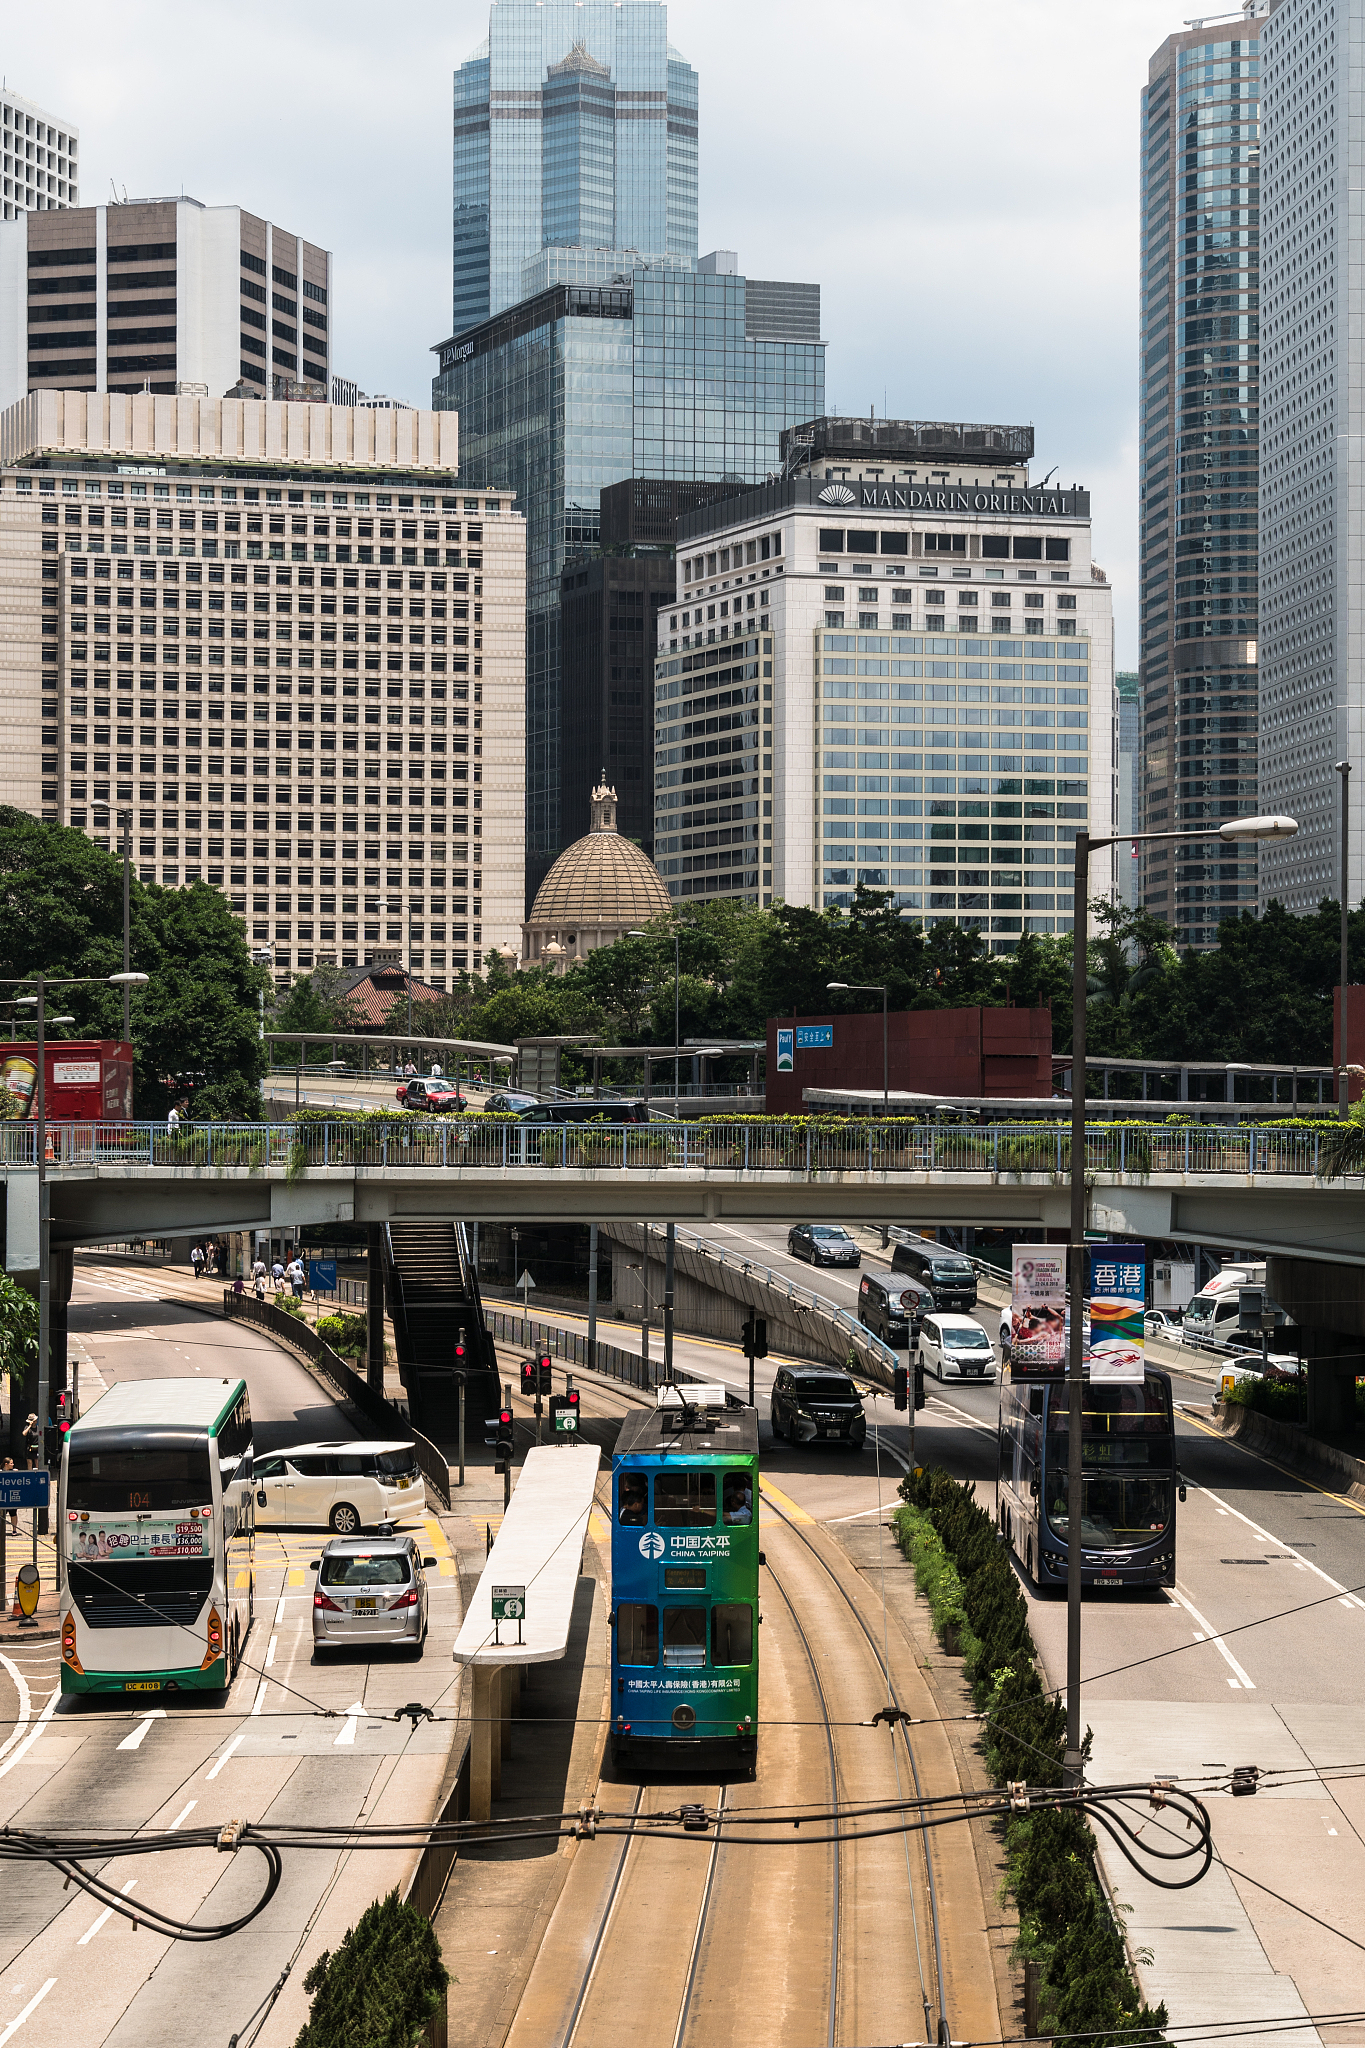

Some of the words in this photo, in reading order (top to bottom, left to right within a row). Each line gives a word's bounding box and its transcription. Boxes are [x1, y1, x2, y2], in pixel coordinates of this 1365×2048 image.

[862, 488, 969, 510] MANDARIN
[974, 493, 1071, 514] ORIENTAL
[58, 1064, 96, 1072] KERRY
[1094, 1264, 1141, 1286] 香港
[1082, 1443, 1113, 1456] 彩虹
[129, 1492, 150, 1508] 104
[176, 1525, 202, 1533] $19,500
[670, 1535, 731, 1549] 中国太平
[176, 1546, 203, 1555] $10,000
